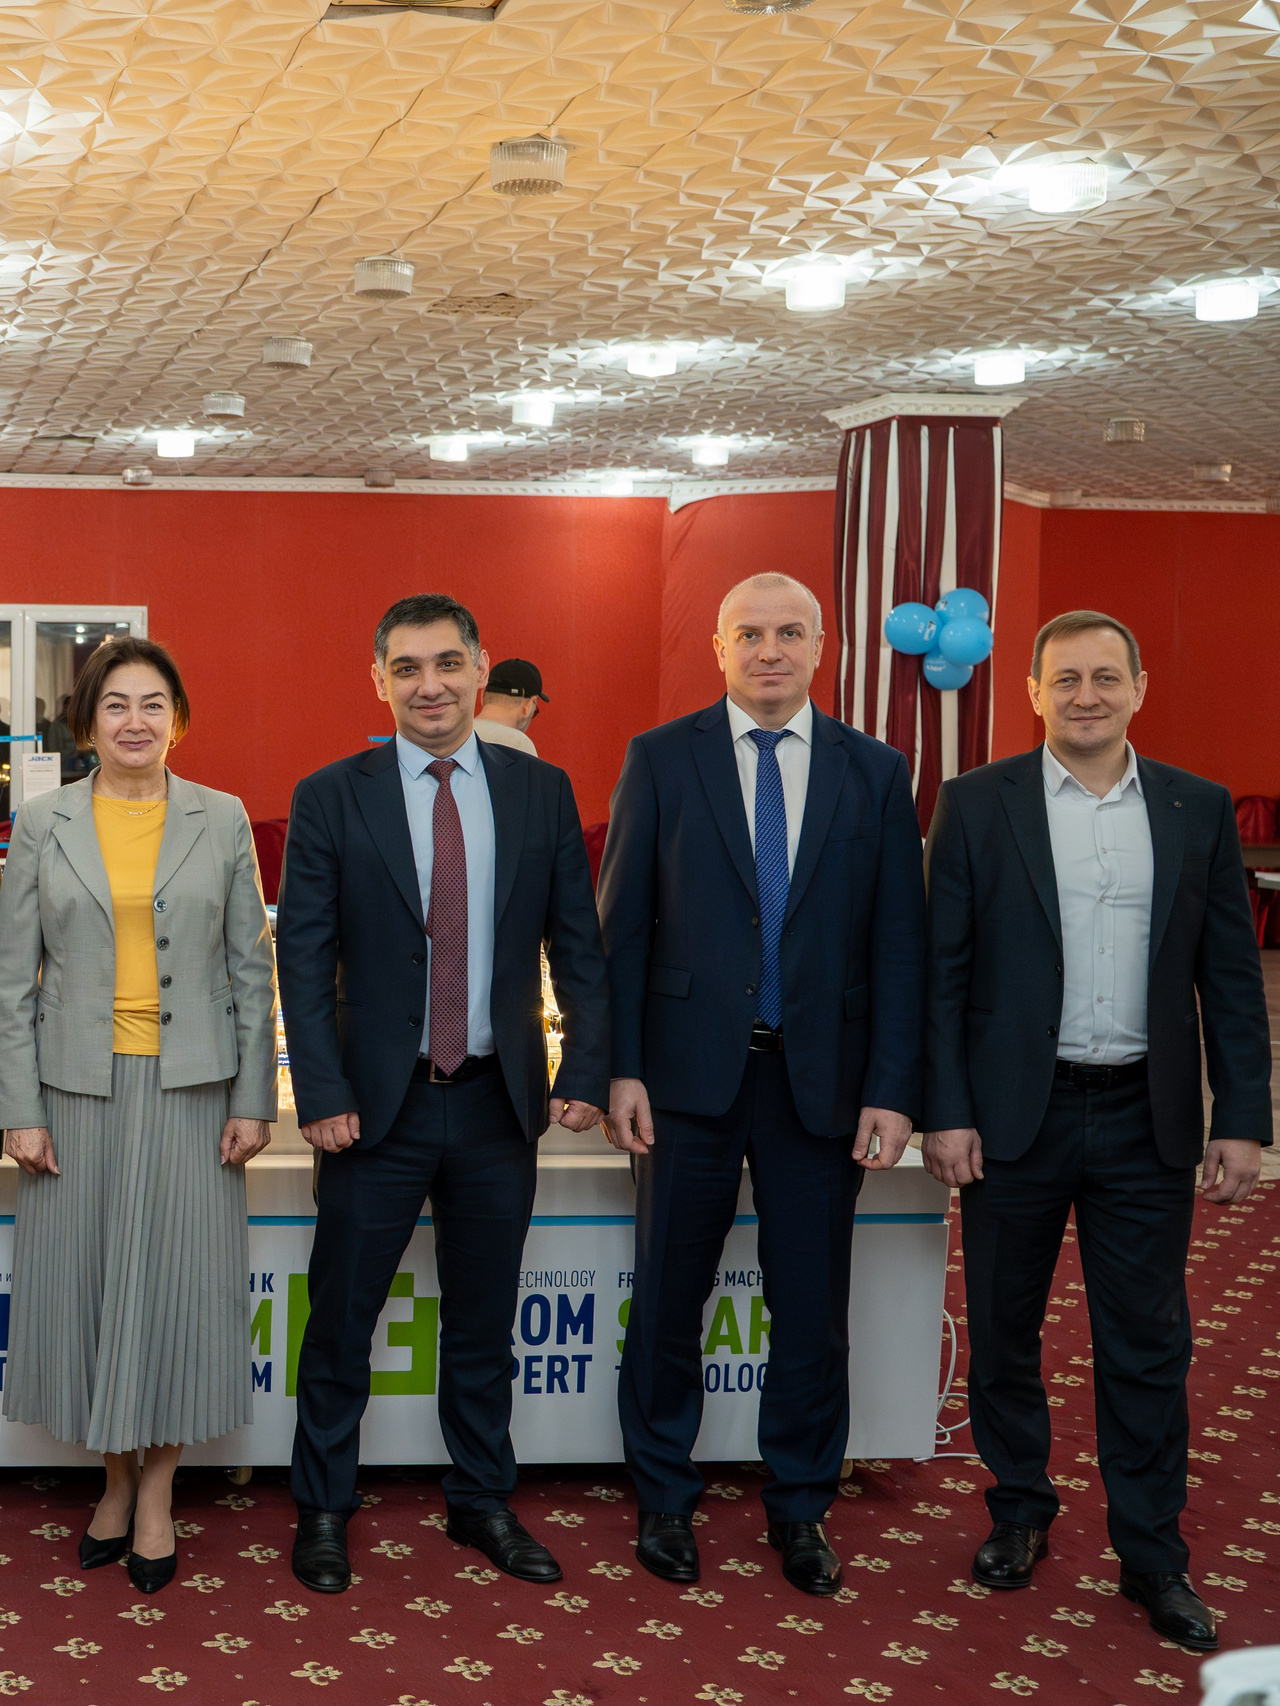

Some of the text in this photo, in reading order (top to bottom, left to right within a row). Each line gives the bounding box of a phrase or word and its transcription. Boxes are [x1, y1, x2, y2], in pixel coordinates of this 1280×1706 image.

[518, 1270, 596, 1288] ECHNOLOGY
[724, 1270, 764, 1287] MACH
[511, 1354, 593, 1394] ERT
